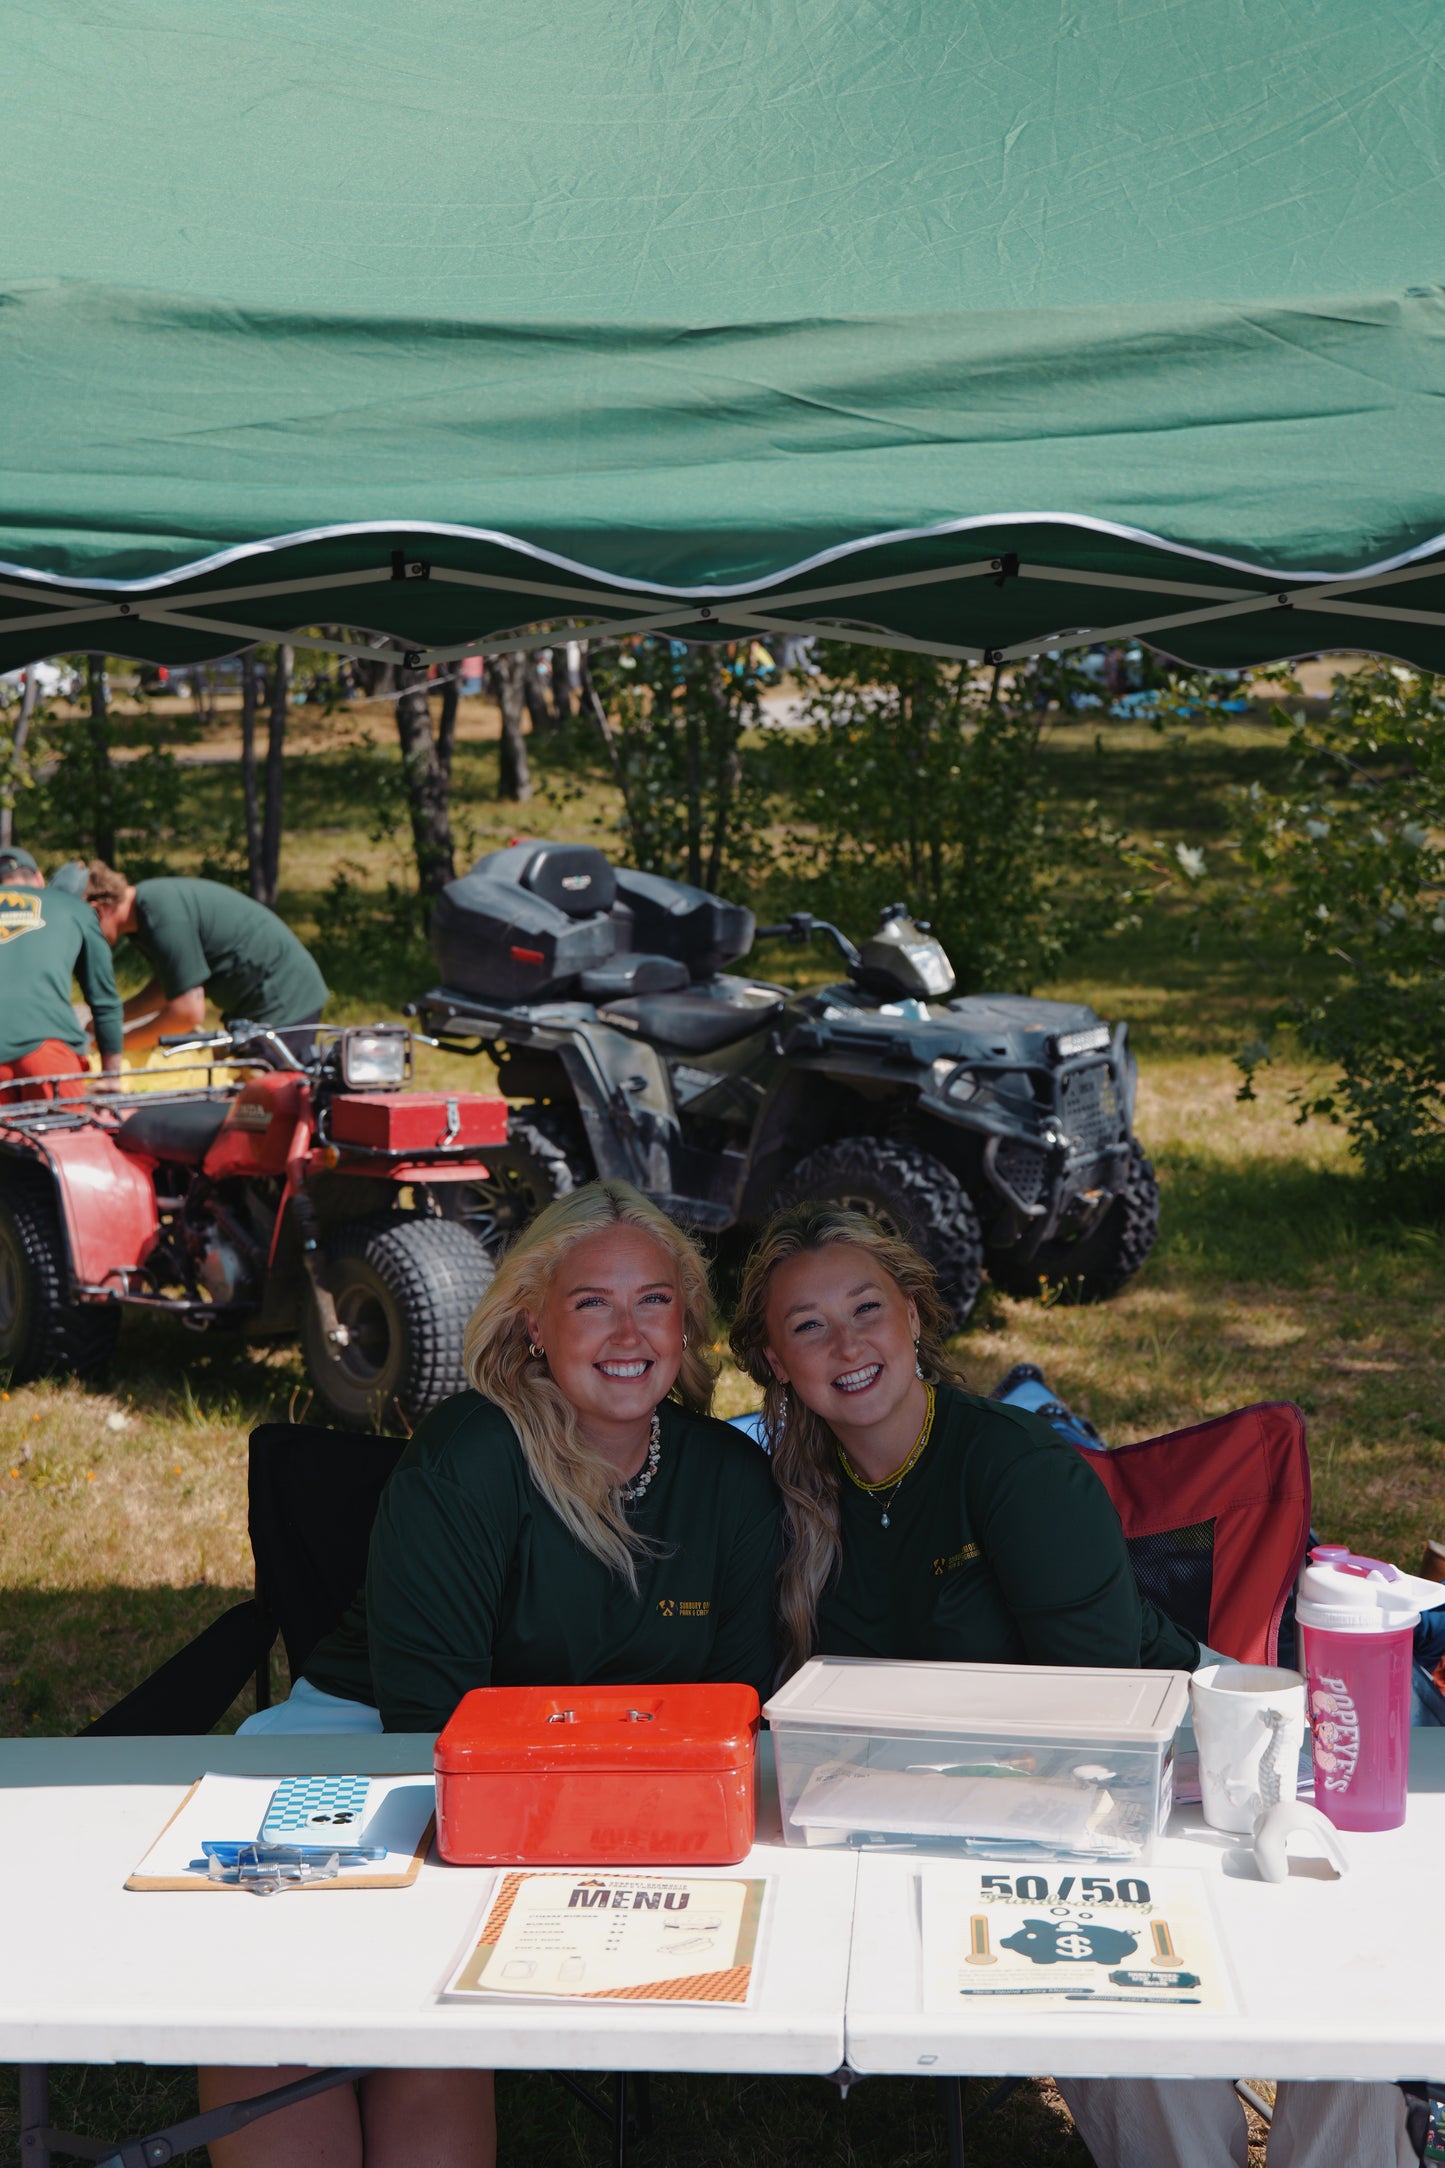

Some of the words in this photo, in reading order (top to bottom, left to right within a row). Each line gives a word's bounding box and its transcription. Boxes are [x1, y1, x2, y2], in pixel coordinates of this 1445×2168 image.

[1319, 1675, 1360, 1793] POPEYE'S
[568, 1889, 690, 1910] MENU
[980, 1875, 1151, 1904] 50/50
